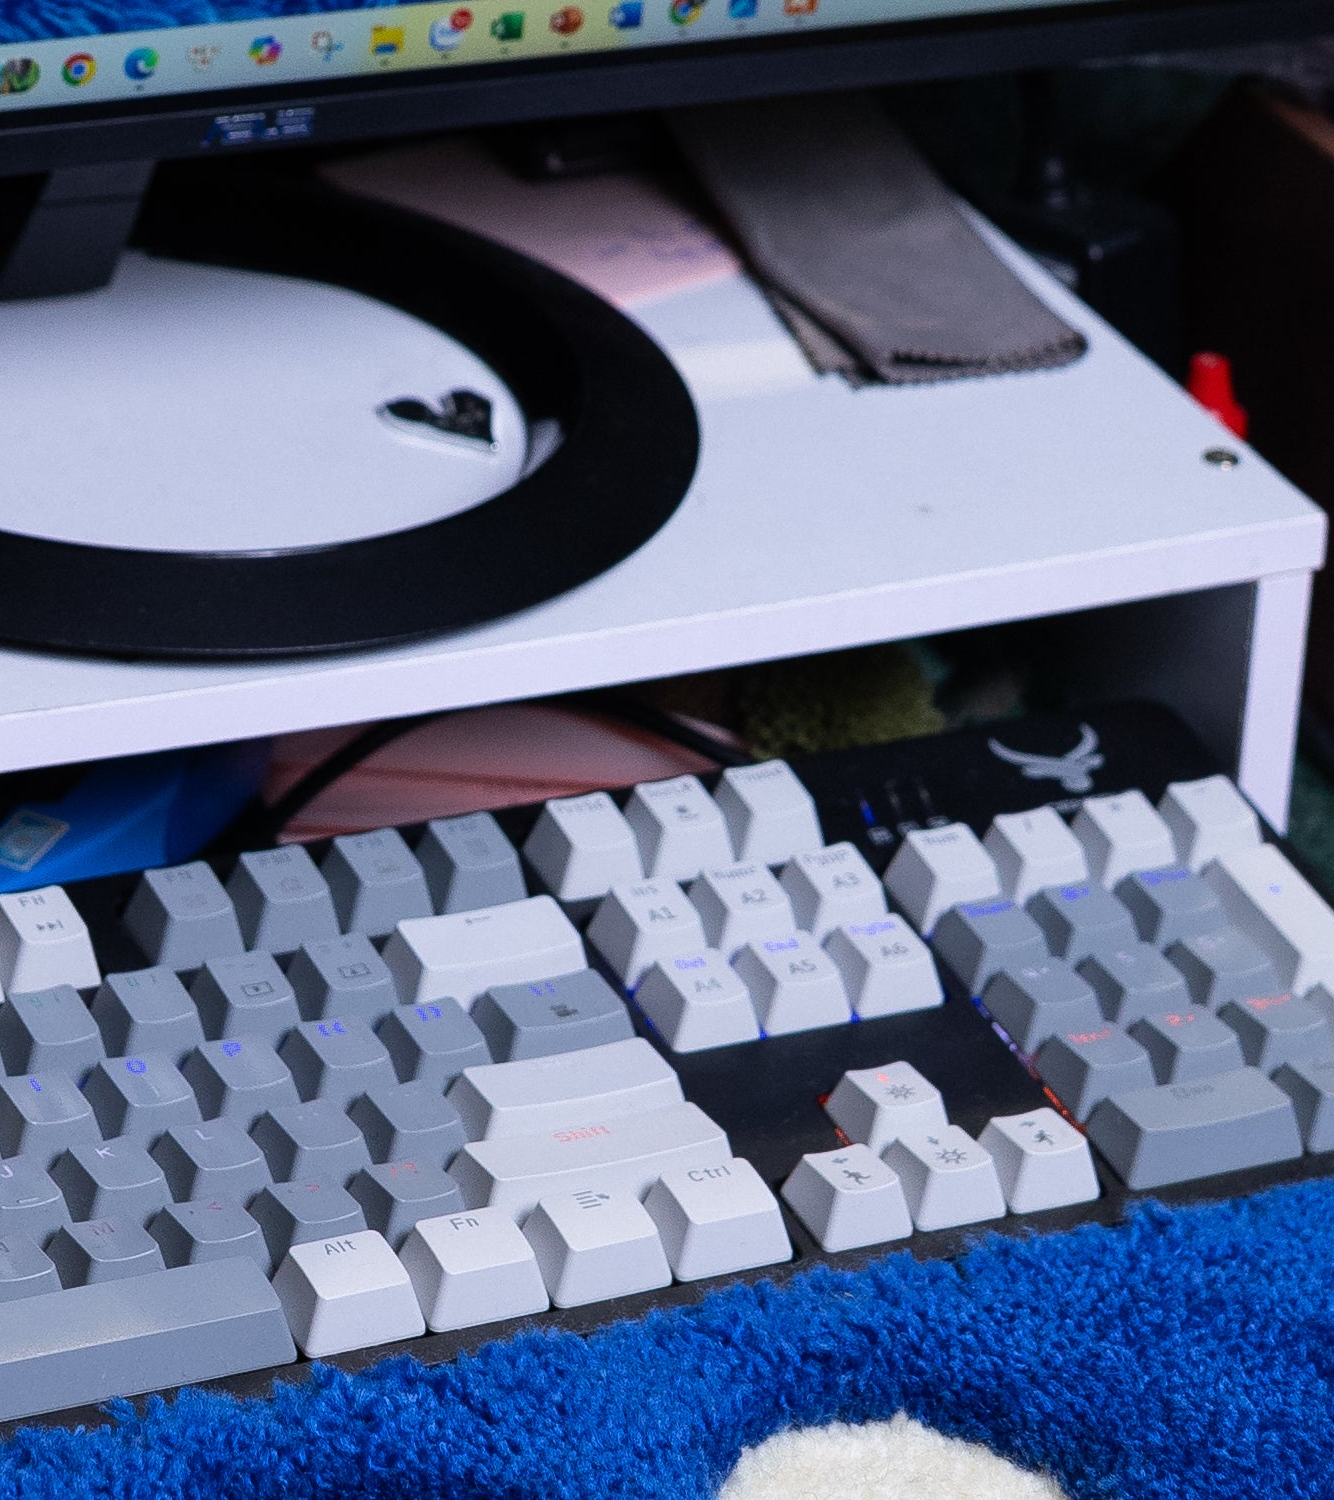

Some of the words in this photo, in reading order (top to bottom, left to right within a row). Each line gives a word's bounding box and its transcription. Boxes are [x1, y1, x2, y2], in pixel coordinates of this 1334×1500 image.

[194, 1129, 215, 1141] L
[553, 1125, 611, 1143] Shift
[93, 1147, 116, 1159] K
[0, 1164, 14, 1179] J
[687, 1165, 731, 1182] Ctrl
[449, 1217, 479, 1231] Fn
[323, 1238, 357, 1256] Alt
